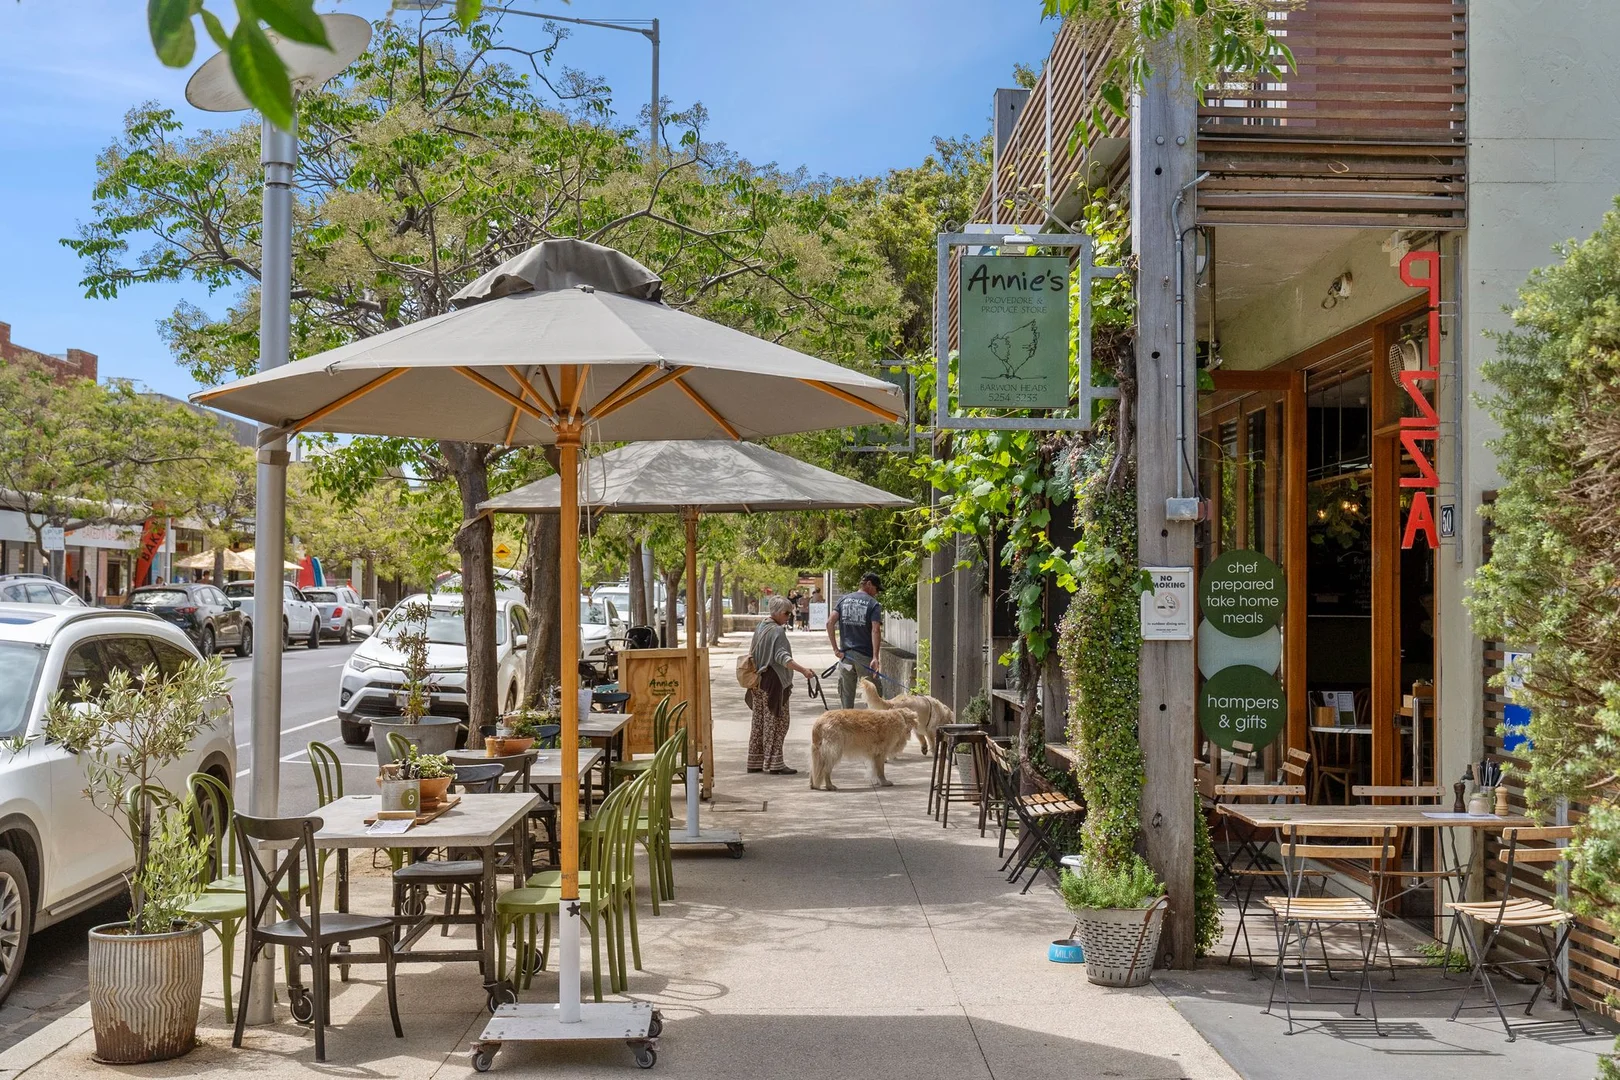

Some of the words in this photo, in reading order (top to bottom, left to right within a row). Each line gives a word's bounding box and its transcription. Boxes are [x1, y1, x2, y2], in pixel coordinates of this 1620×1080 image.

[967, 263, 1064, 295] Annie's
[985, 296, 1033, 304] PROVEDORE
[981, 305, 1018, 314] PRODUCE
[1021, 305, 1047, 314] STORE
[979, 383, 1018, 392] BARWON
[1020, 383, 1047, 392] HEADS
[988, 393, 1011, 402] 5254
[1015, 393, 1038, 402] 3233
[1442, 509, 1453, 532] 50
[1227, 561, 1258, 574] chef
[1211, 578, 1274, 593] prepared
[1206, 595, 1236, 607] take
[1239, 595, 1279, 607] home
[1223, 611, 1264, 624] meals
[649, 678, 679, 689] Annie's
[1207, 694, 1279, 712] hampers
[1218, 714, 1231, 729] &
[1235, 713, 1267, 732] gifts
[408, 794, 414, 805] 9
